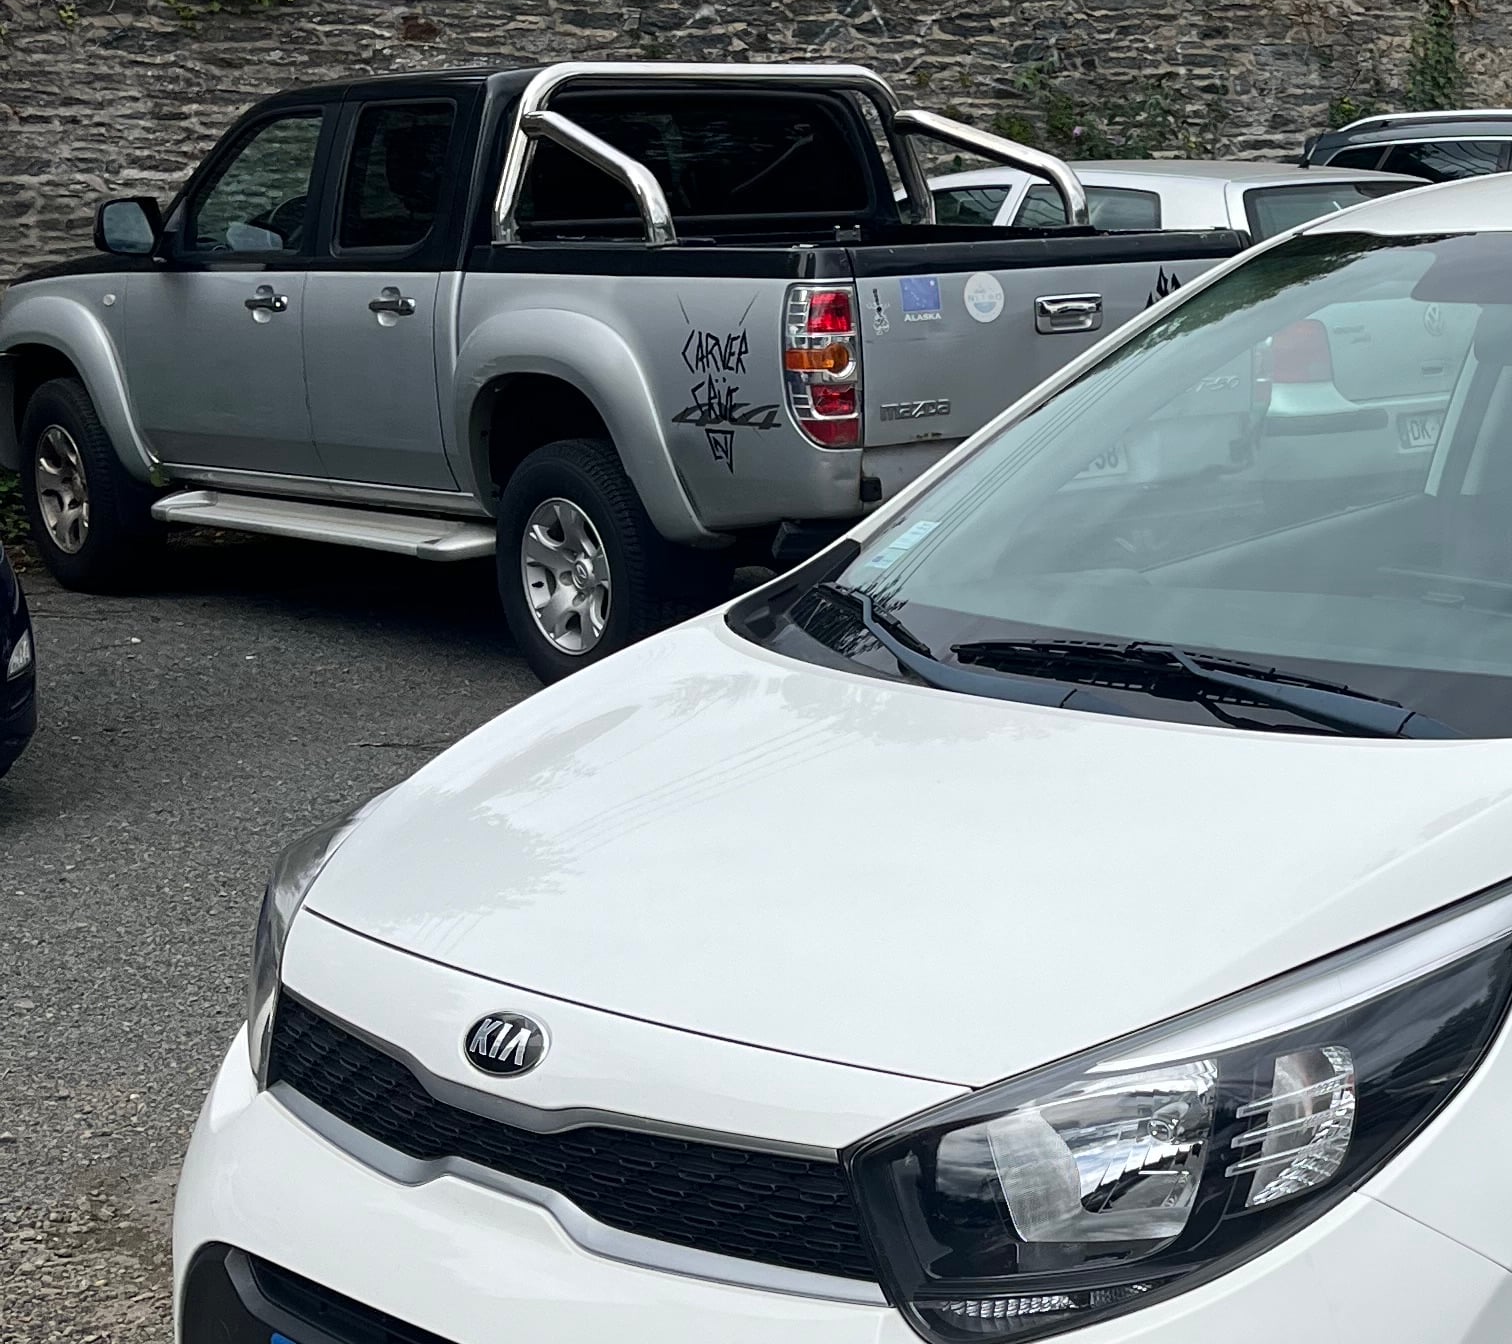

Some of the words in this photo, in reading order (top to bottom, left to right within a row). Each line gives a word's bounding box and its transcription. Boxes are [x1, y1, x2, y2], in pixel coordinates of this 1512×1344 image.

[904, 312, 942, 322] ALASKA
[681, 328, 749, 375] CARVER
[469, 1018, 532, 1066] KIA
